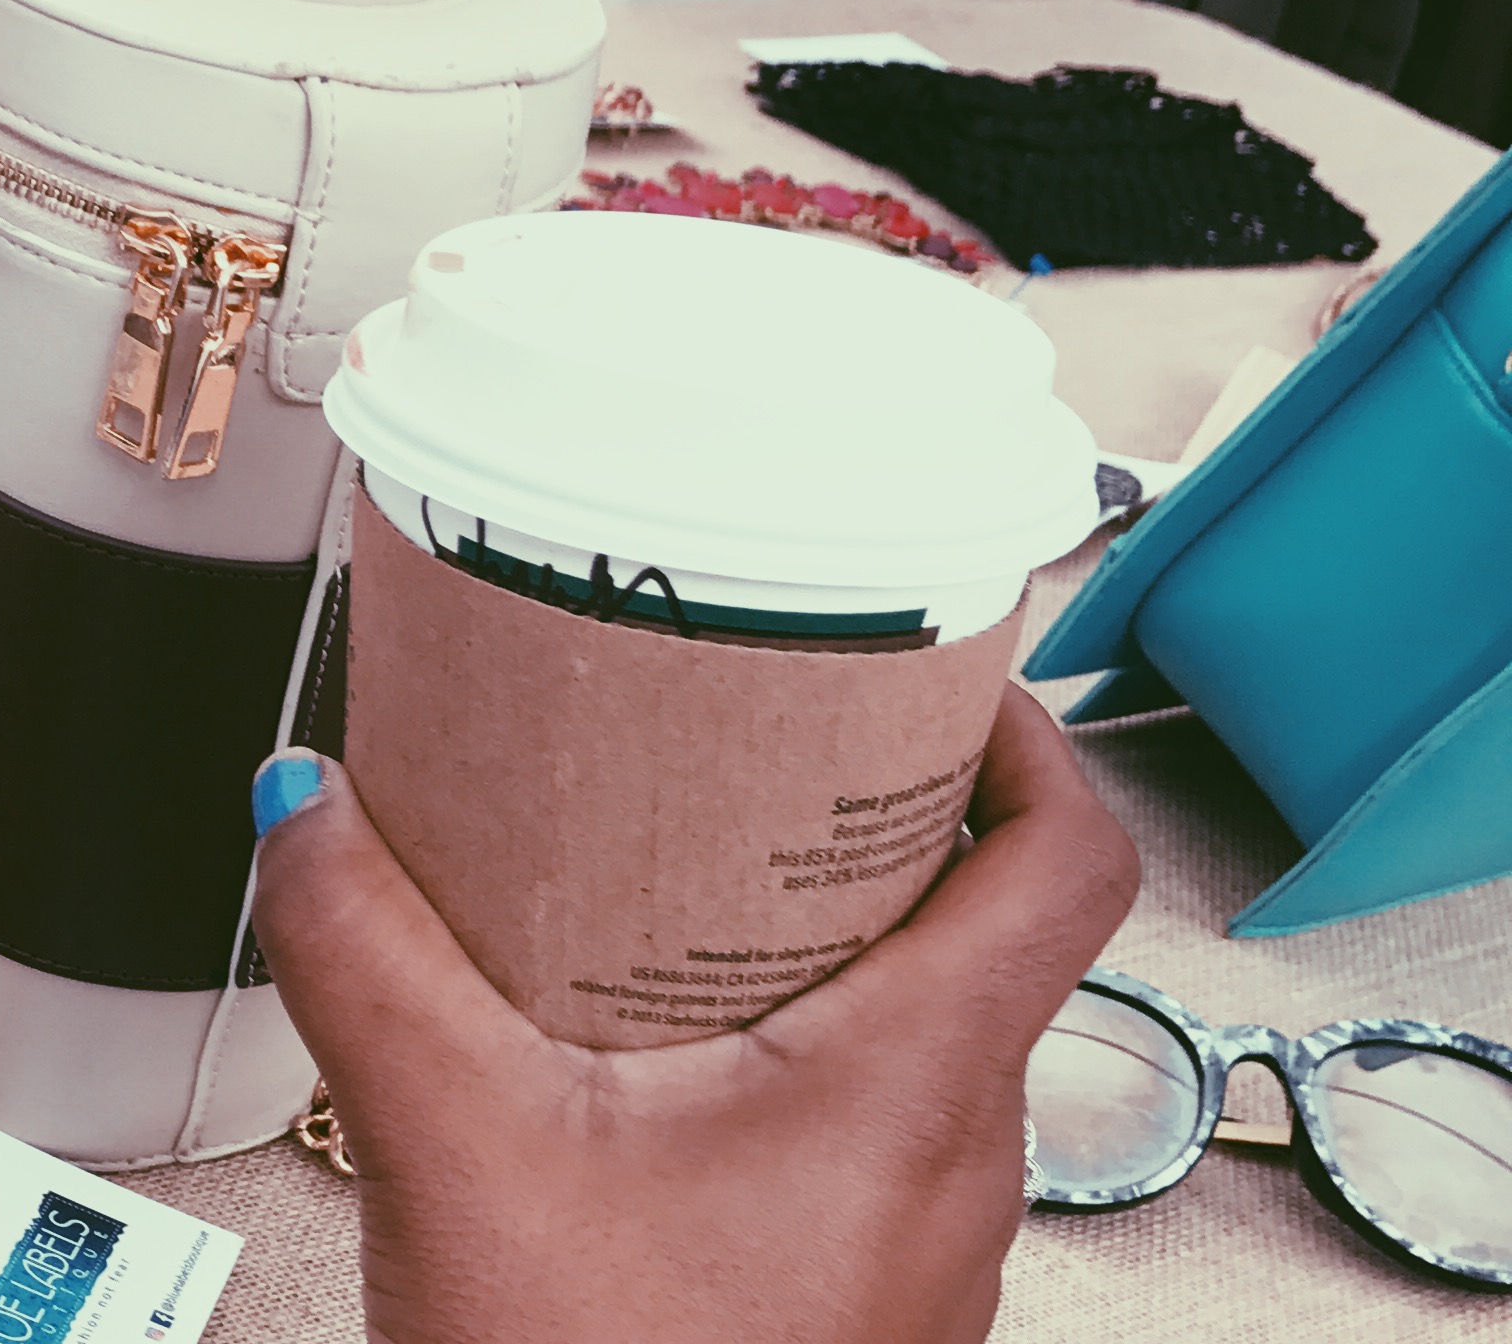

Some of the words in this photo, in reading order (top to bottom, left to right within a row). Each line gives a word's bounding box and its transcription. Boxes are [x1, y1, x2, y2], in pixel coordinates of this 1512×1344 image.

[832, 795, 879, 815] Same
[769, 850, 801, 867] this
[783, 875, 819, 890] uses
[687, 947, 753, 963] Intended
[754, 948, 775, 962] for
[631, 966, 652, 981] US
[569, 979, 617, 997] related
[618, 984, 668, 1006] foreign
[668, 993, 719, 1009] patents
[719, 992, 745, 1006] and
[662, 1012, 718, 1028] Starbucks
[10, 1209, 91, 1301] LABELS
[96, 1284, 117, 1308] not
[108, 1258, 131, 1285] fear
